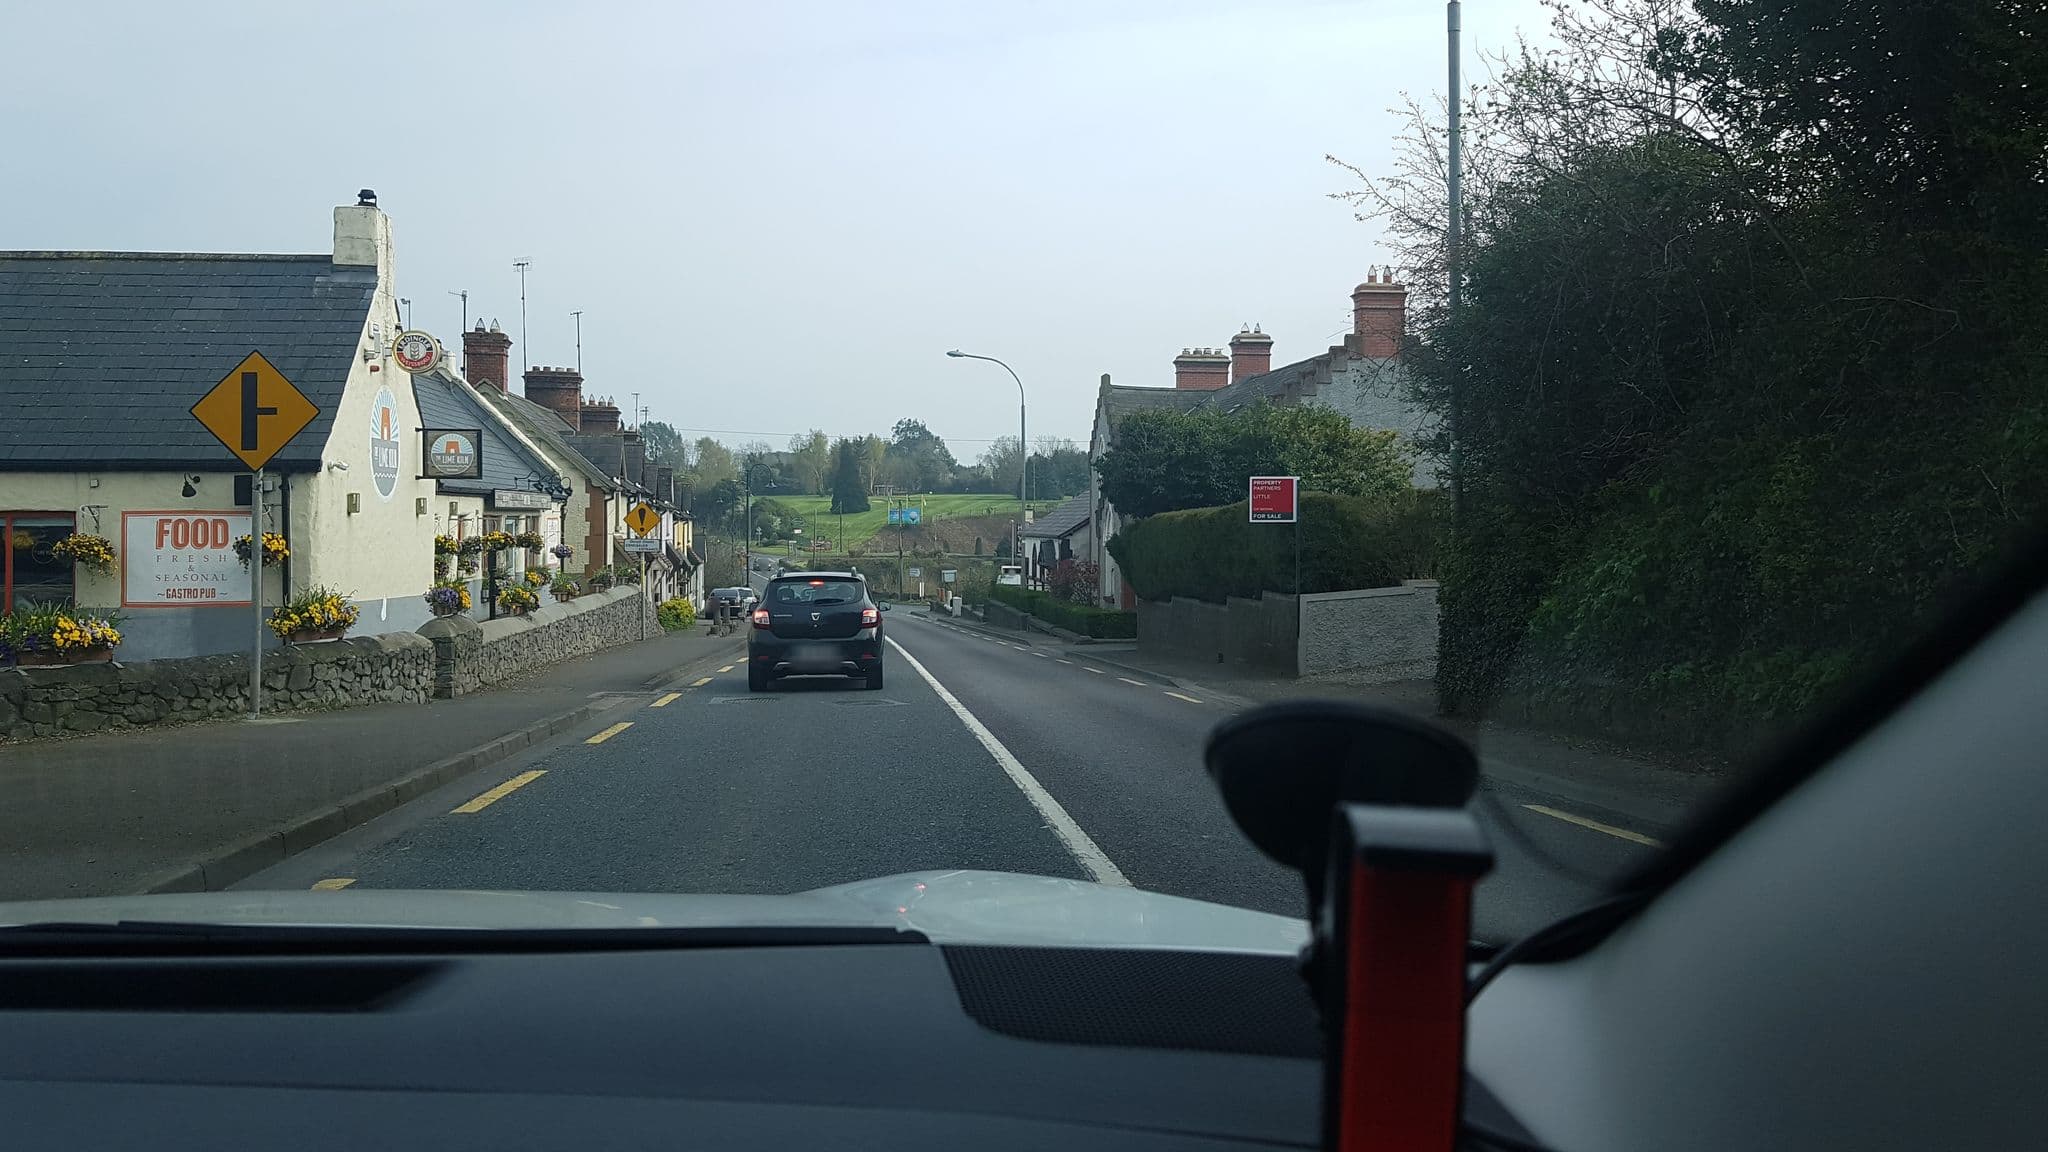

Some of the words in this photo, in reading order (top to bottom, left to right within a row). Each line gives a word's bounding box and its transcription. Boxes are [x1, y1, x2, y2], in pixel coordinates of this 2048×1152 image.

[397, 335, 432, 349] ERDINGER
[379, 447, 388, 467] LIME
[443, 455, 455, 464] LIME
[156, 518, 229, 550] FOOD
[156, 554, 227, 562] FRESH
[187, 564, 194, 572] &
[155, 573, 228, 581] SEASONAL
[166, 588, 198, 599] GASTRO
[200, 588, 216, 598] PUB
